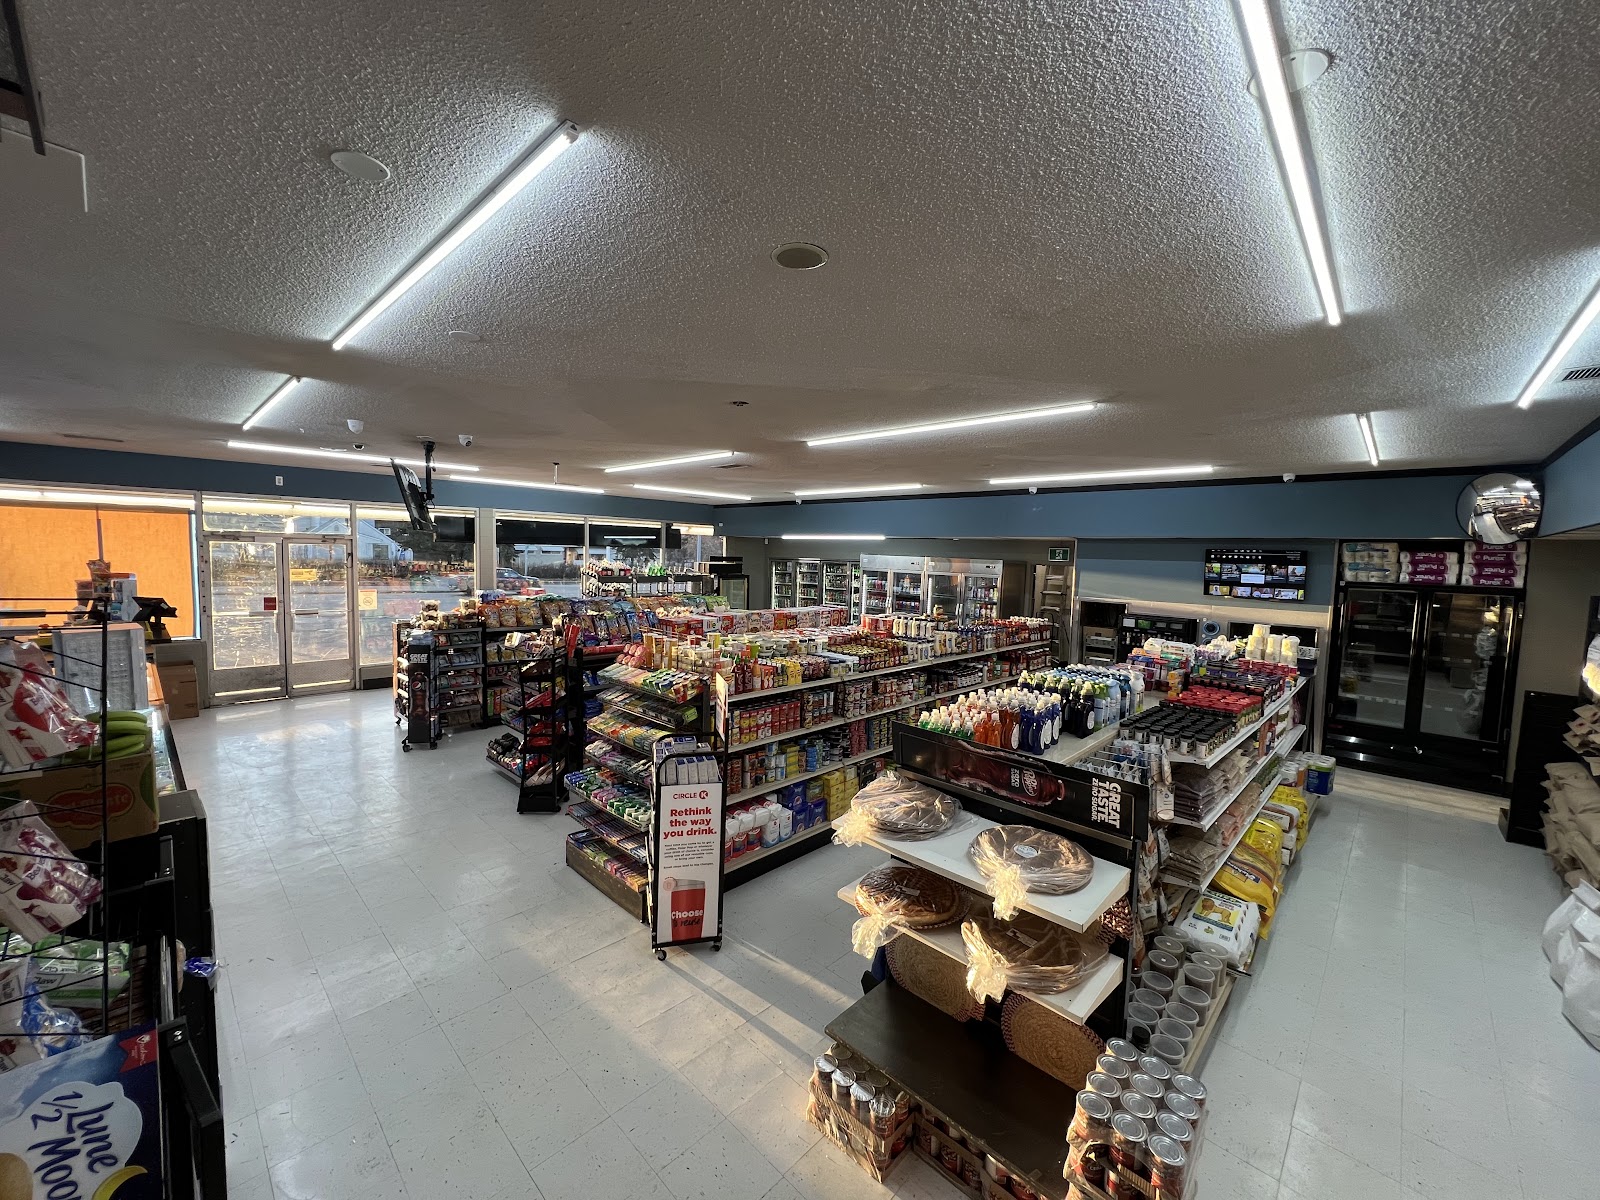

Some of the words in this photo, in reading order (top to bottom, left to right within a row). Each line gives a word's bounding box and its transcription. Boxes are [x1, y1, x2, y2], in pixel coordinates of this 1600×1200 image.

[699, 790, 708, 800] K
[670, 806, 712, 817] Rethink
[1108, 782, 1122, 828] GREAT
[670, 819, 688, 828] the
[690, 818, 712, 826] way
[663, 830, 684, 840] you
[686, 826, 717, 836] drink.
[66, 1102, 118, 1173] Lune
[27, 1136, 82, 1200] Moo
